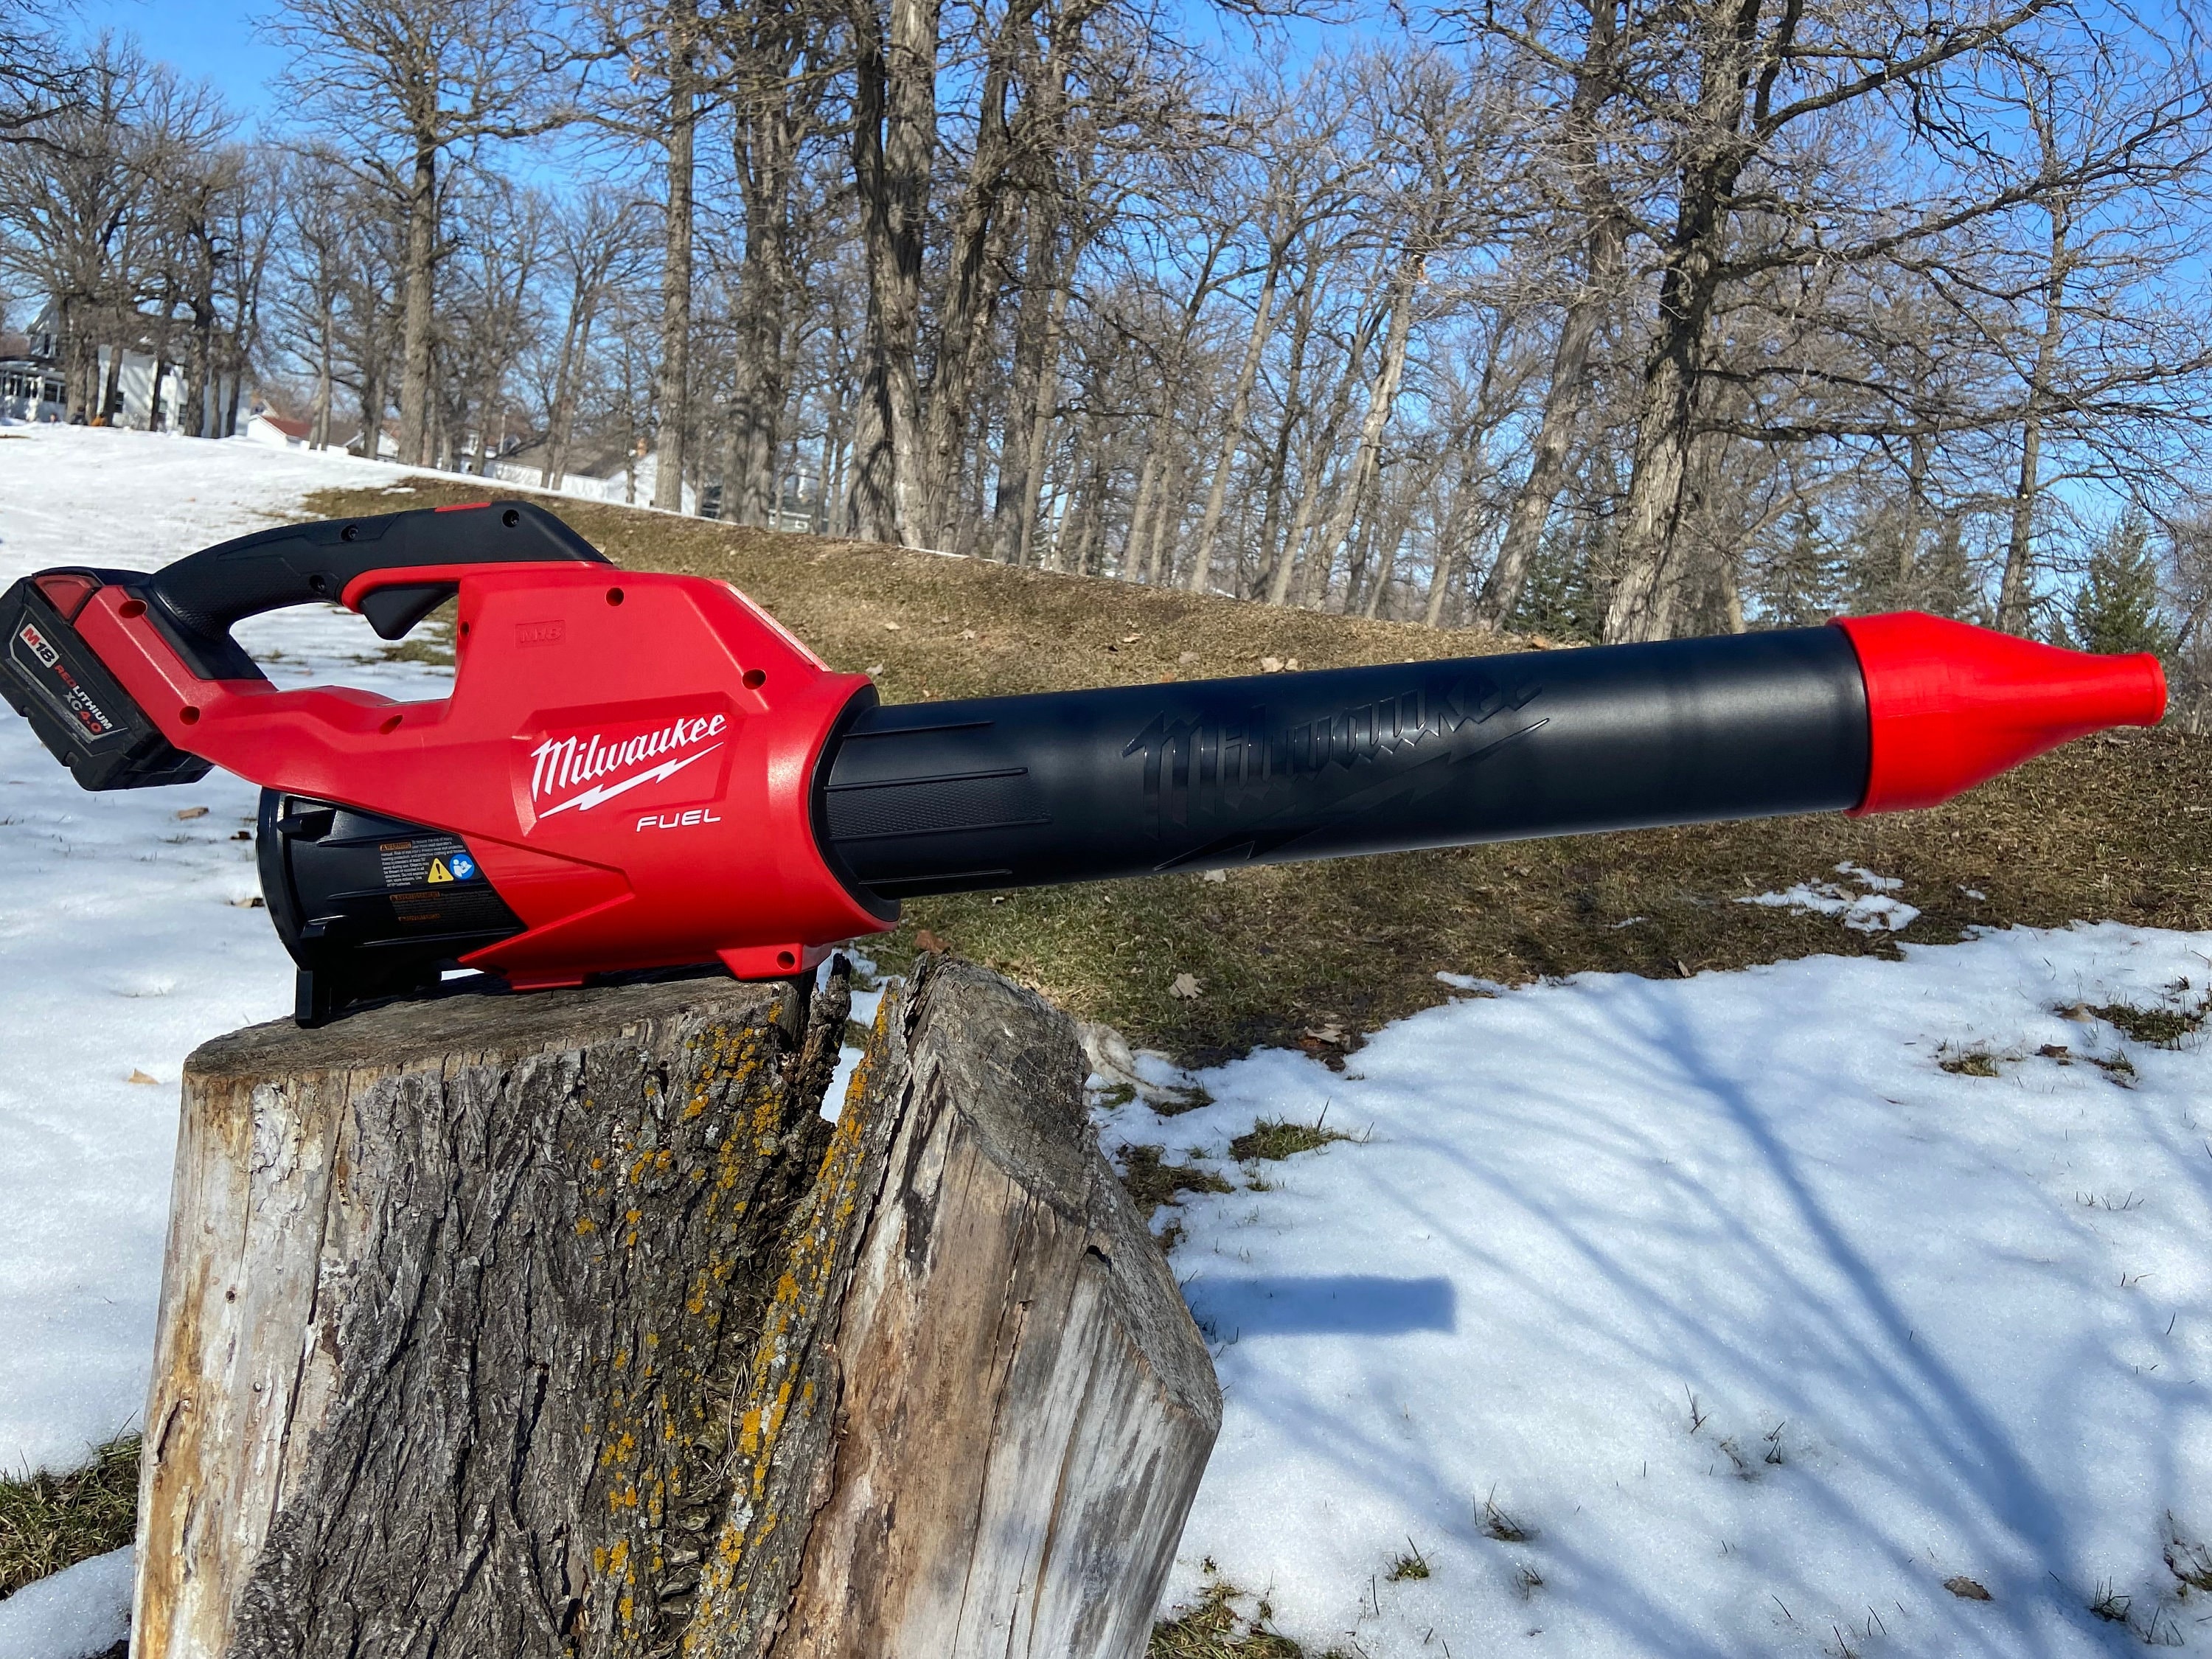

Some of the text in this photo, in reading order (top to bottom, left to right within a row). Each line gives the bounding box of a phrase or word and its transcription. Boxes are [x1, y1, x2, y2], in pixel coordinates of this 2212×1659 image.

[24, 627, 55, 662] M18
[54, 664, 114, 730] REDLITHIUM
[530, 714, 728, 803] Milwaukee
[1121, 674, 1543, 841] Milwaukee
[636, 808, 722, 832] FUEL
